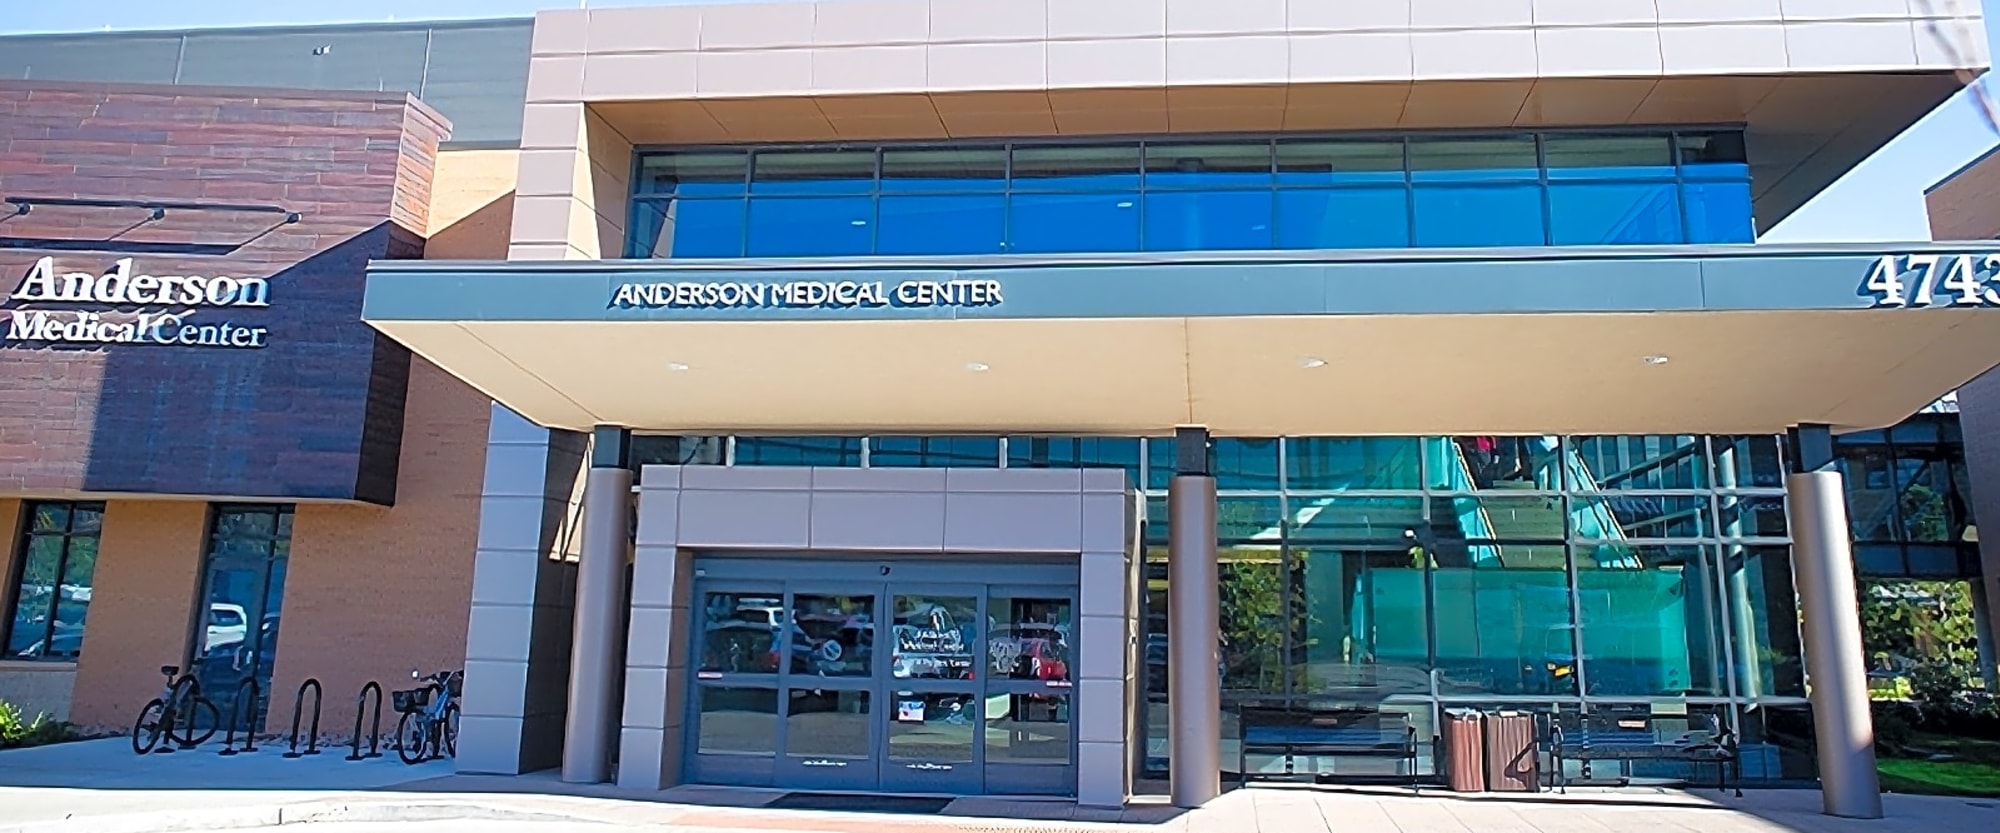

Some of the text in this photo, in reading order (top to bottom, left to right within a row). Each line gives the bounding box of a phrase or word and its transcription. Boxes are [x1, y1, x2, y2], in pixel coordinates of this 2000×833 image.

[10, 256, 270, 307] Anderson
[613, 280, 1004, 306] ANDERSON MEDICAL CENTER
[6, 310, 268, 348] Medical Center
